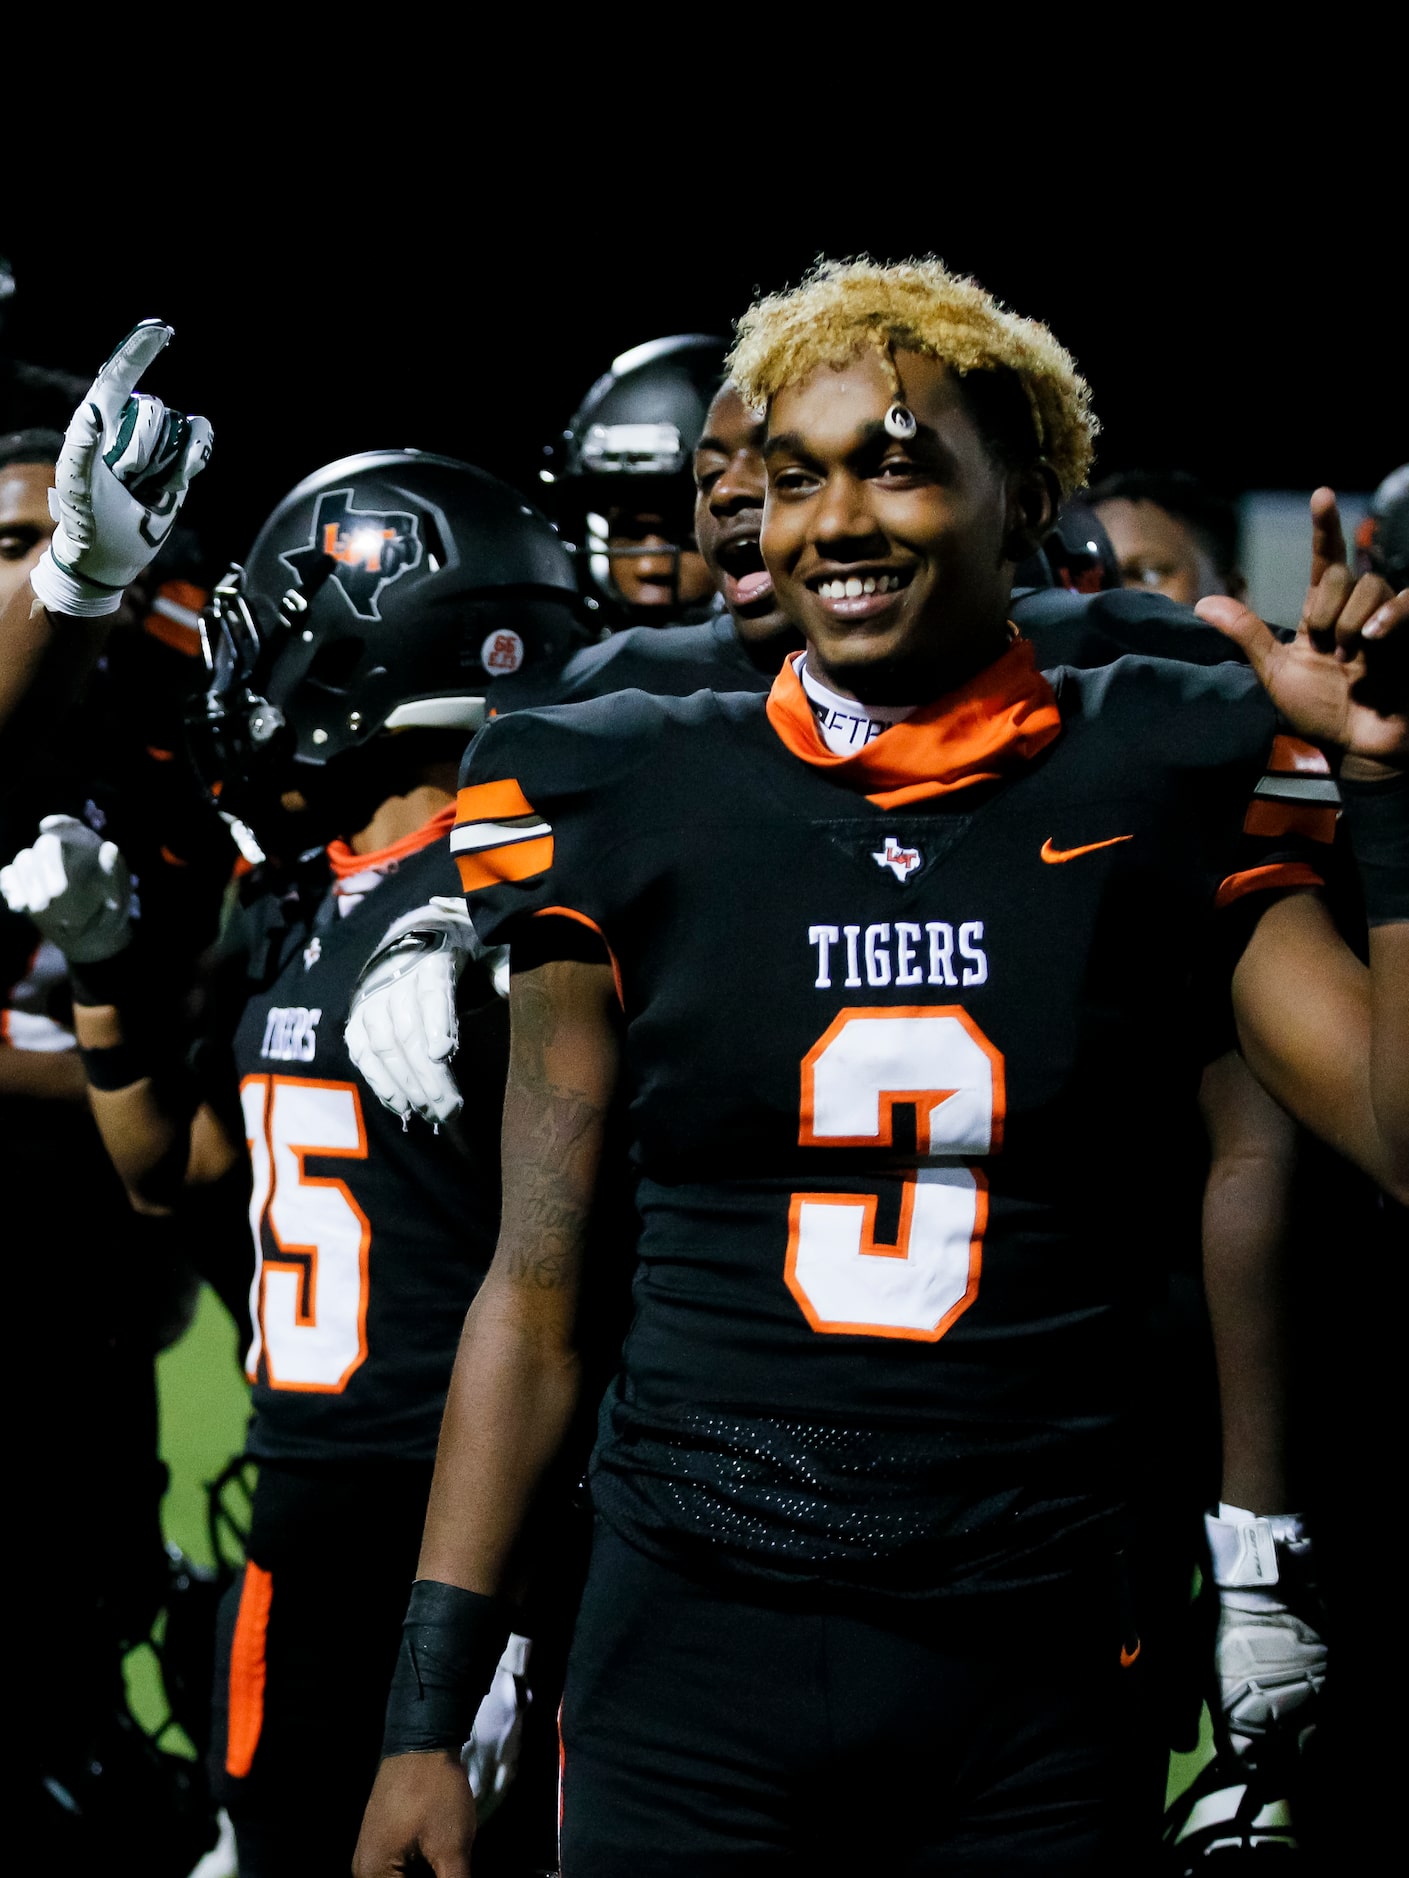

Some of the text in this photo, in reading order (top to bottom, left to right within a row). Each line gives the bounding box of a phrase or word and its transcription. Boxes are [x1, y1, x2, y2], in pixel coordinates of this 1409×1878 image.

[828, 711, 895, 747] FTP
[809, 921, 988, 988] TIGERS
[240, 1072, 372, 1394] 15
[784, 1005, 1005, 1342] 3
